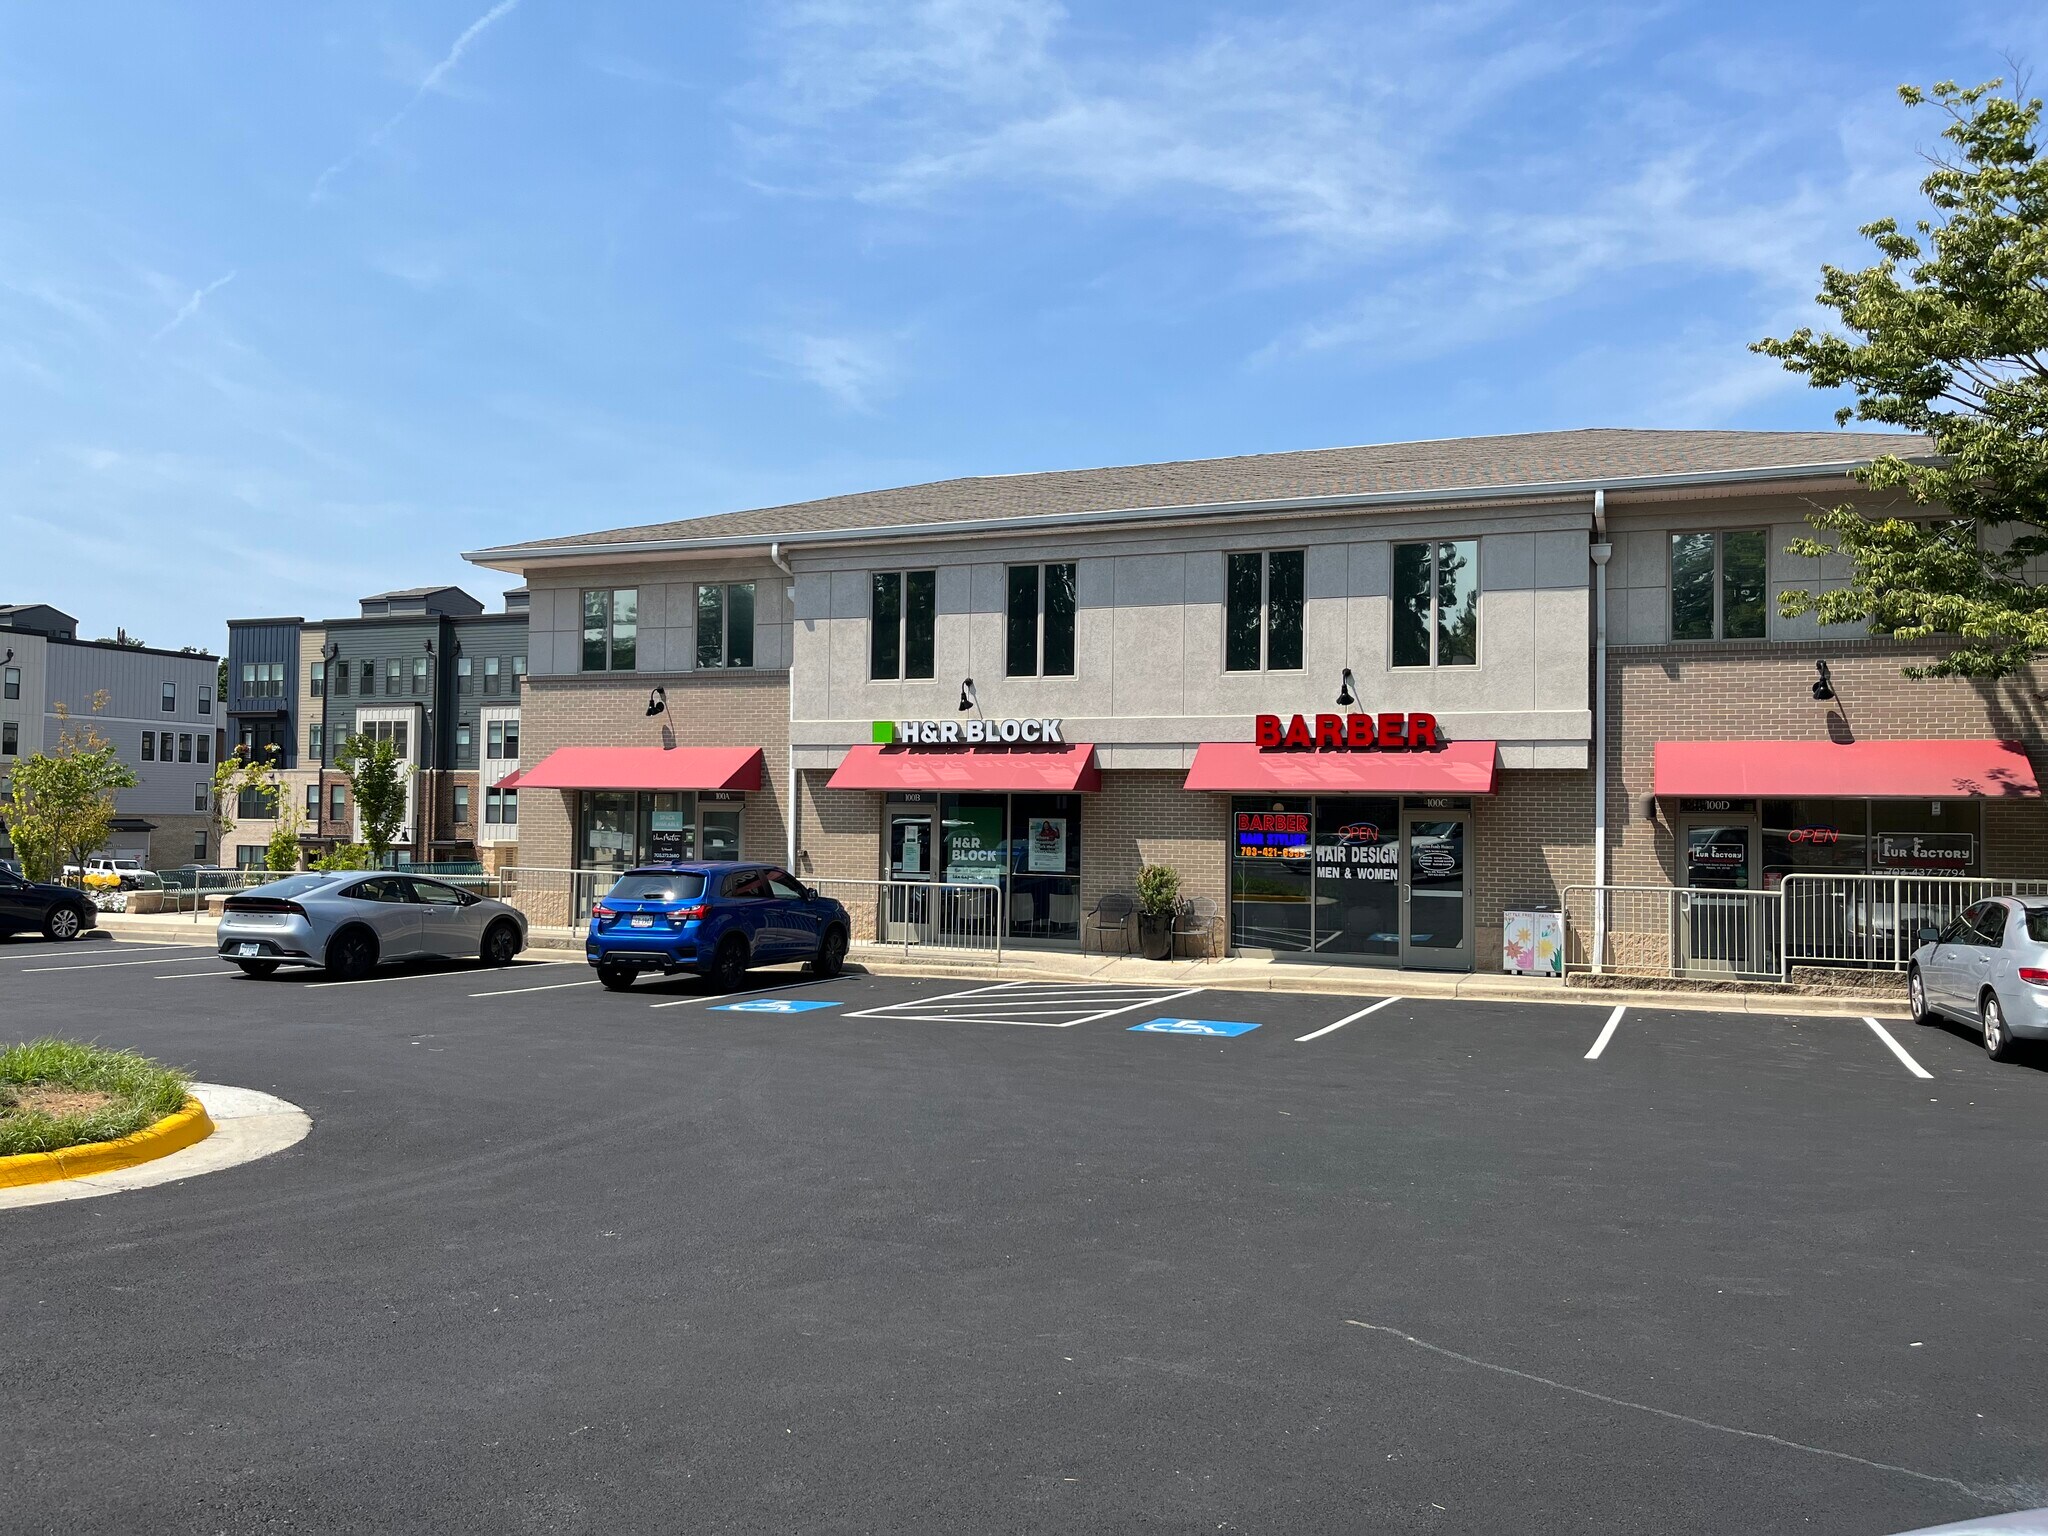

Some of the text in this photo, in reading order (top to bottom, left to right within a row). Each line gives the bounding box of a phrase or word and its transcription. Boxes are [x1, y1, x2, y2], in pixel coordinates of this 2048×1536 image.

[901, 719, 1062, 743] H&R BLOCK
[1256, 713, 1437, 747] BARBER
[904, 793, 921, 802] 100B
[1427, 799, 1448, 808] 100C
[1706, 801, 1730, 810] 100D
[1238, 814, 1309, 832] BARBER
[1338, 826, 1379, 841] OPEN
[1787, 829, 1839, 843] OPEN
[952, 837, 981, 849] H&R
[952, 849, 997, 862] BLOCK
[1316, 845, 1398, 864] HAIR DESIGN
[1317, 866, 1398, 880] MEN & WOMEN
